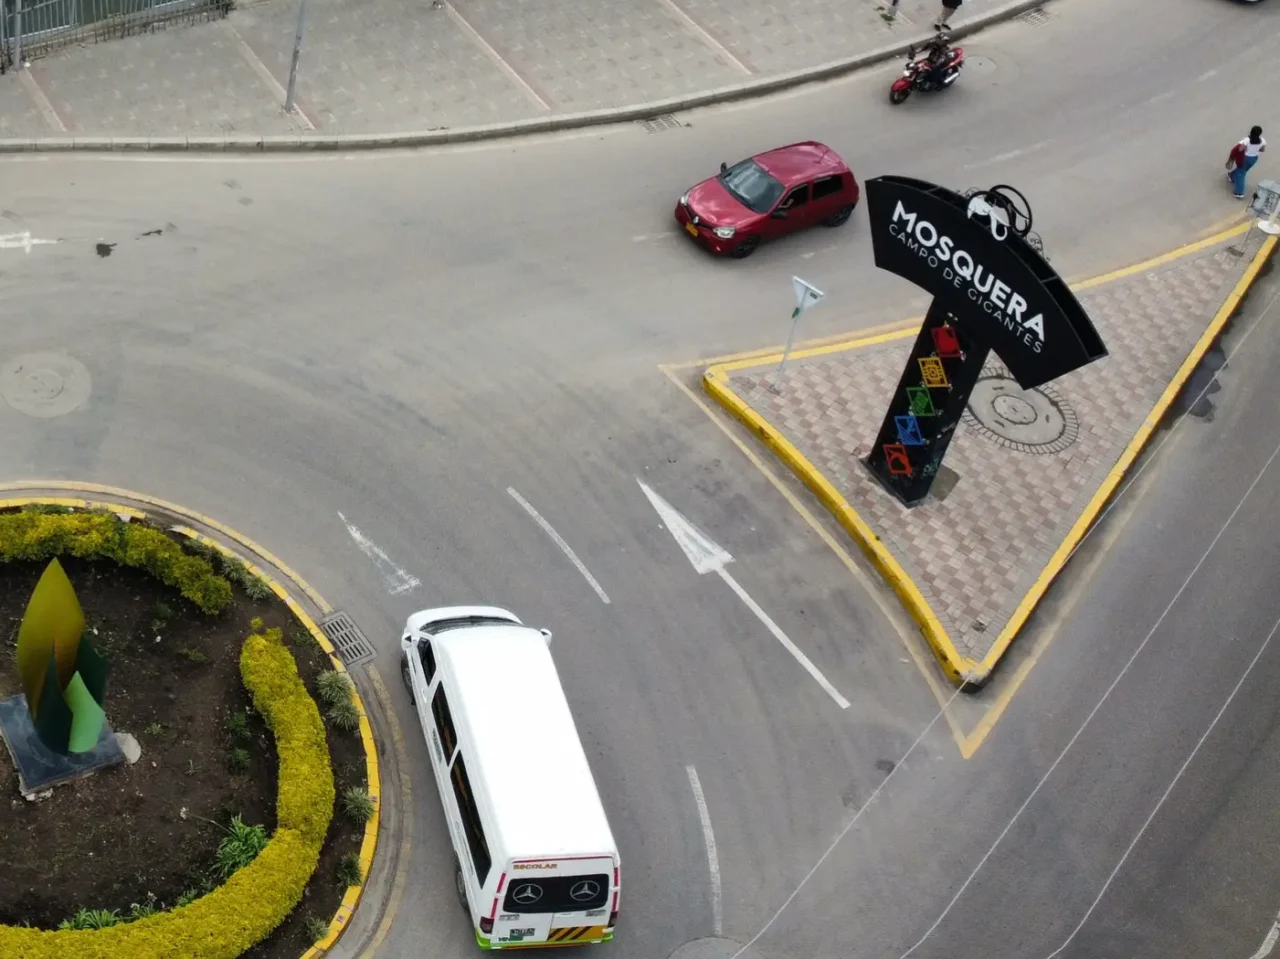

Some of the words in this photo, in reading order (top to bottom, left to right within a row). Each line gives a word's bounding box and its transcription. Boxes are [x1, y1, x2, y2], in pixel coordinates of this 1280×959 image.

[888, 223, 939, 268] CAMPO
[943, 267, 964, 289] DE
[967, 288, 1043, 353] GIGANTES
[892, 200, 1045, 341] MOSQUERA
